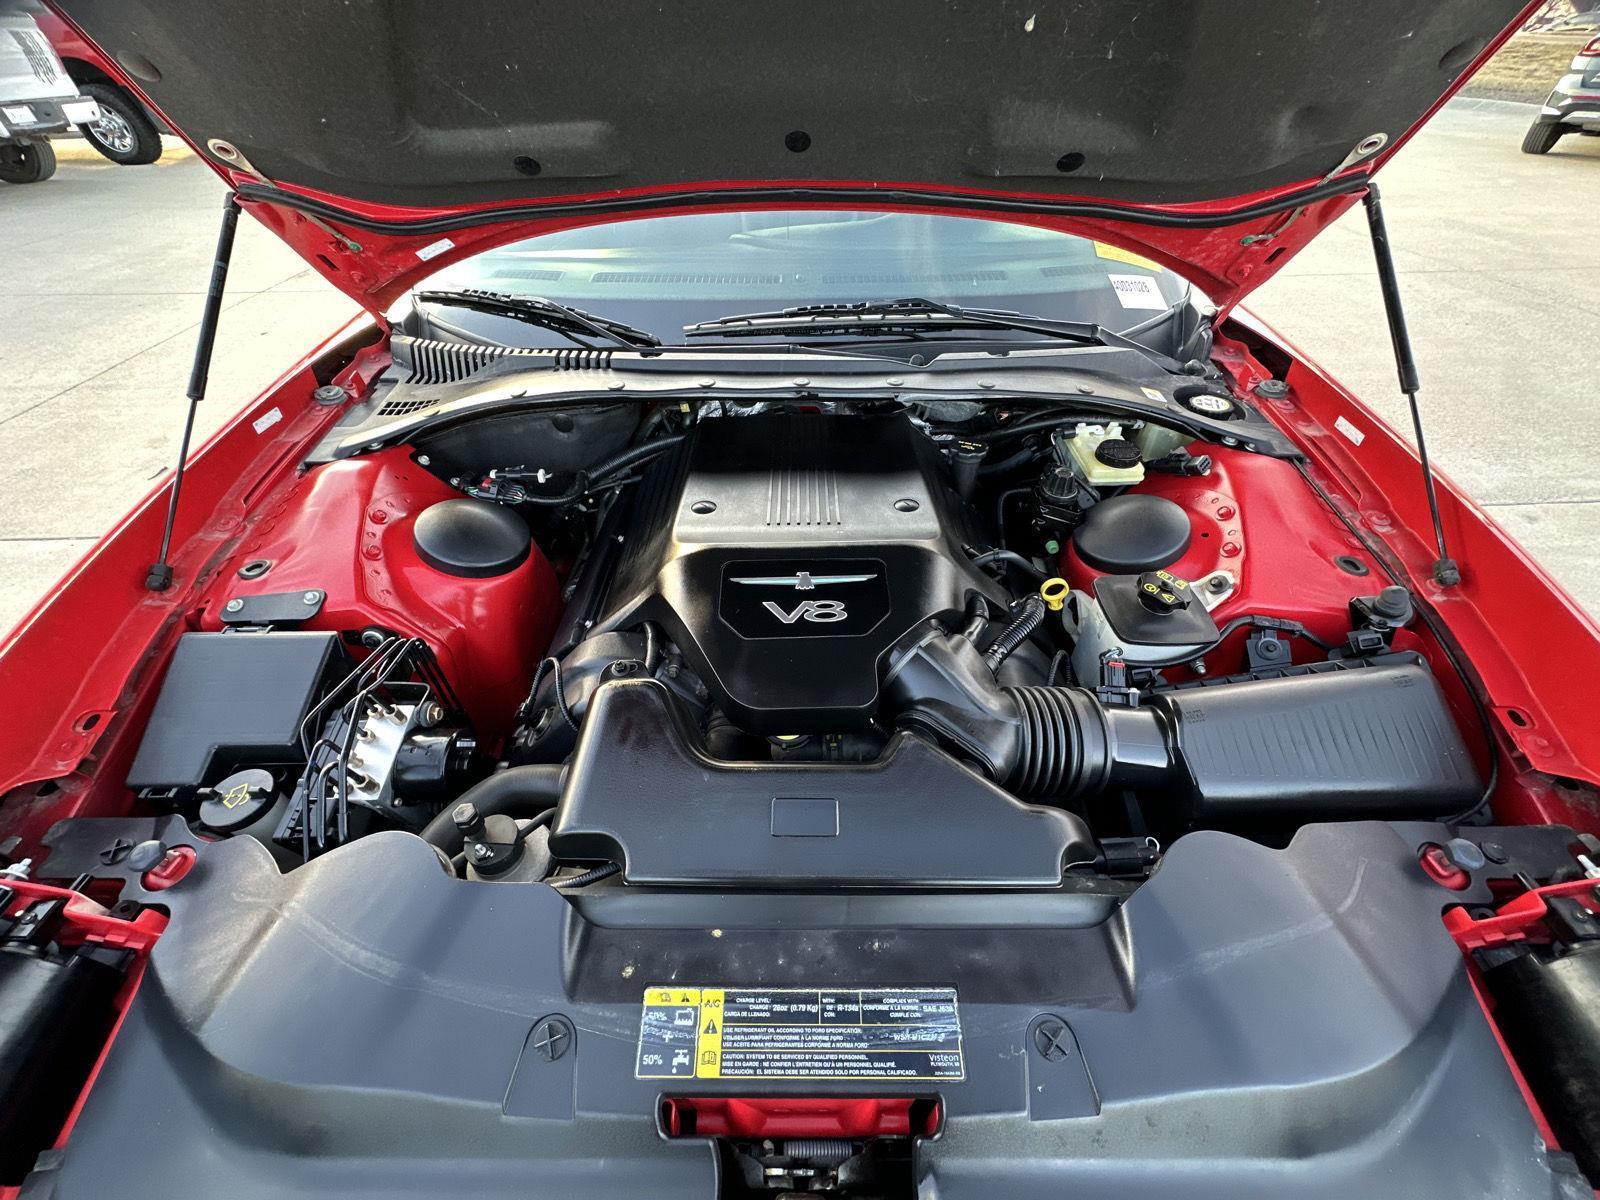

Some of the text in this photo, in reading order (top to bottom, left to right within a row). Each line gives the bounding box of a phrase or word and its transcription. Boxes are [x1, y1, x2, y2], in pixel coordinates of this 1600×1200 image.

[762, 600, 848, 624] V8
[704, 1000, 720, 1008] A/C
[642, 1054, 663, 1064] 50%
[929, 1054, 959, 1062] Visteon
